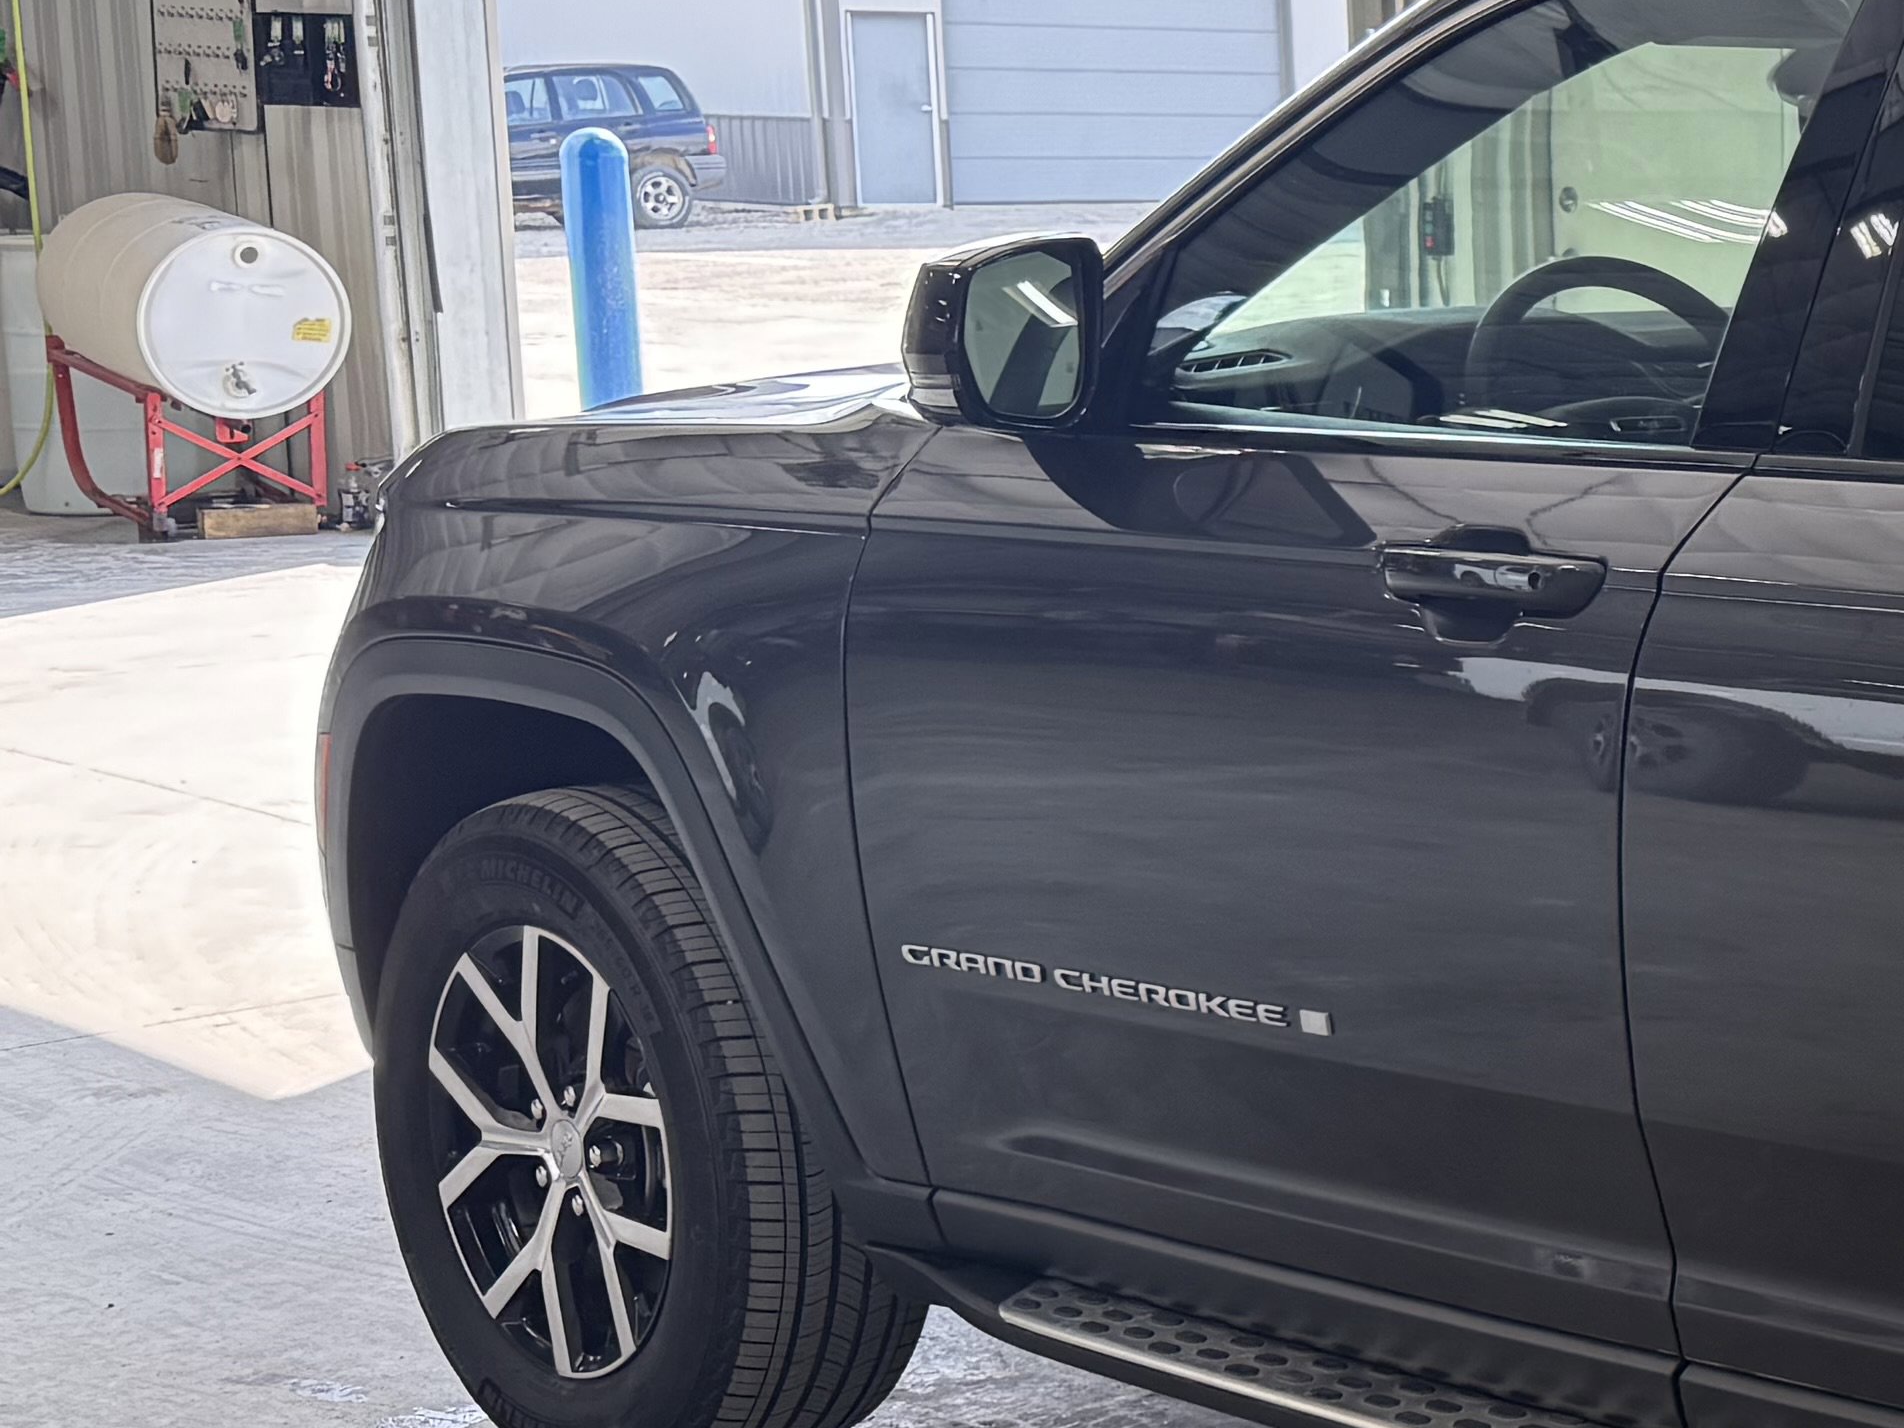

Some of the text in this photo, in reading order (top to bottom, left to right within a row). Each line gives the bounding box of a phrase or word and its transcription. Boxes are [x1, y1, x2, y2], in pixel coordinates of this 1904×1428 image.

[480, 858, 579, 915] MICHELIN
[901, 943, 1289, 1027] GRAND CHEROKEE
